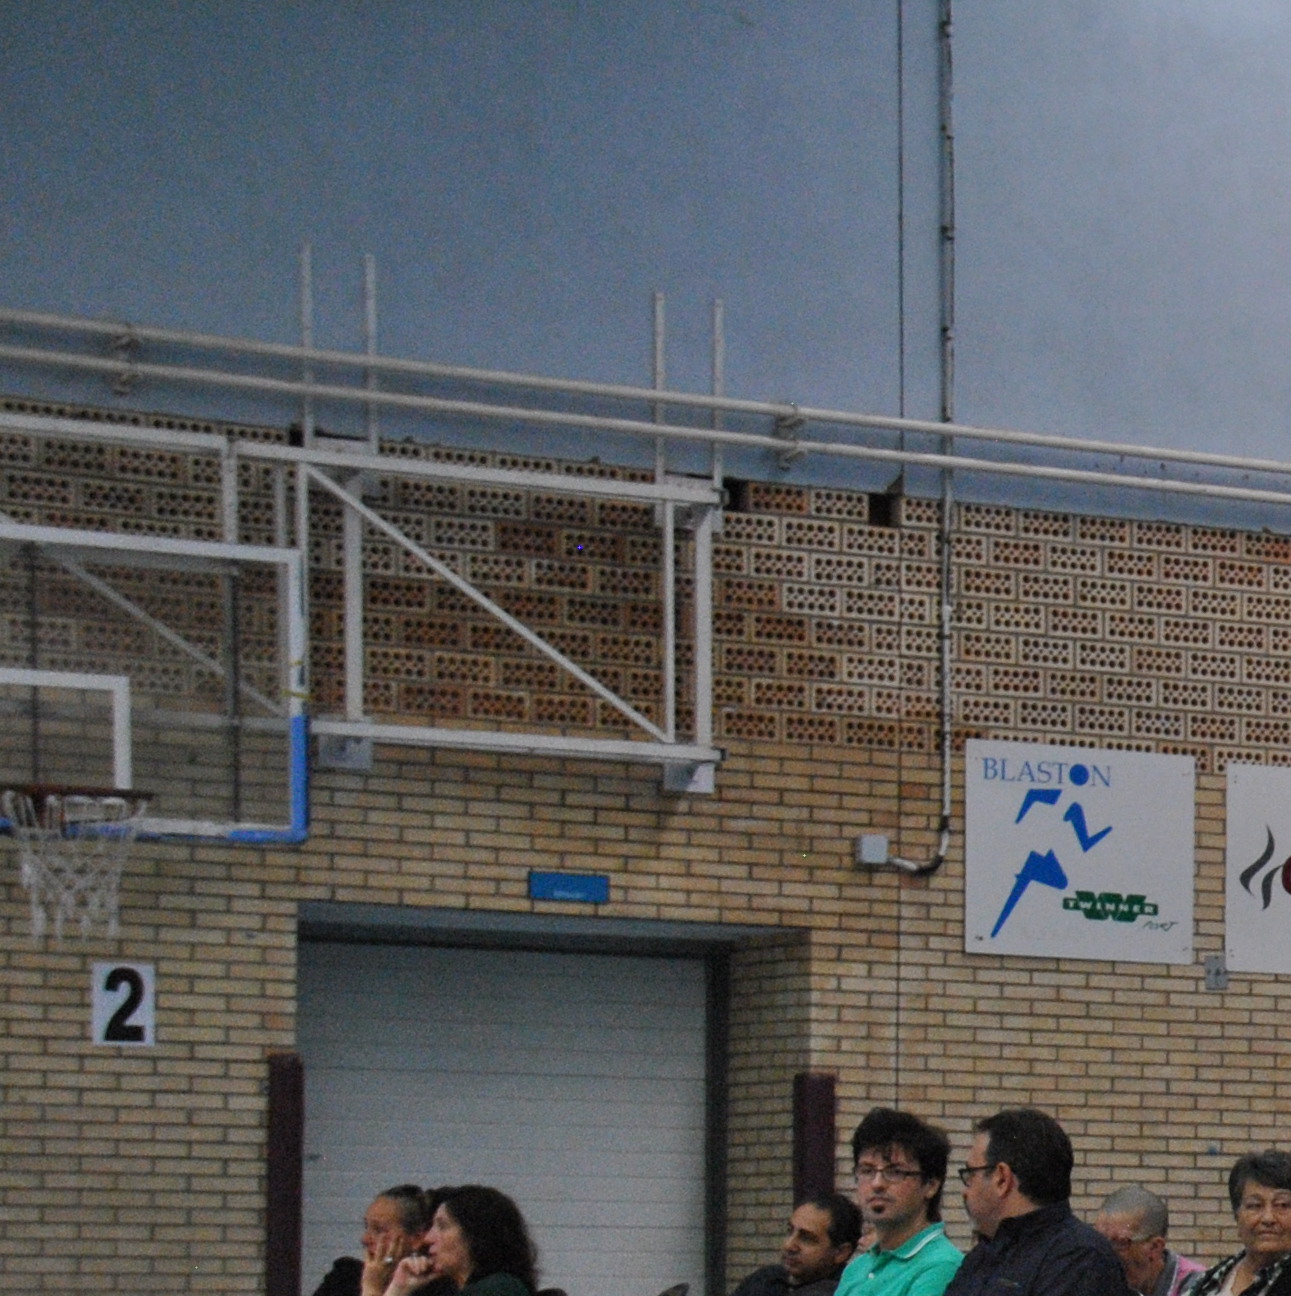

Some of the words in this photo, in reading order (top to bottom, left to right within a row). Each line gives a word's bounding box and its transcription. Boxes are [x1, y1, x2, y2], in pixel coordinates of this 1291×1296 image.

[982, 757, 1111, 787] BLASTON
[1067, 900, 1155, 914] TWINNER
[104, 967, 145, 1042] 2
